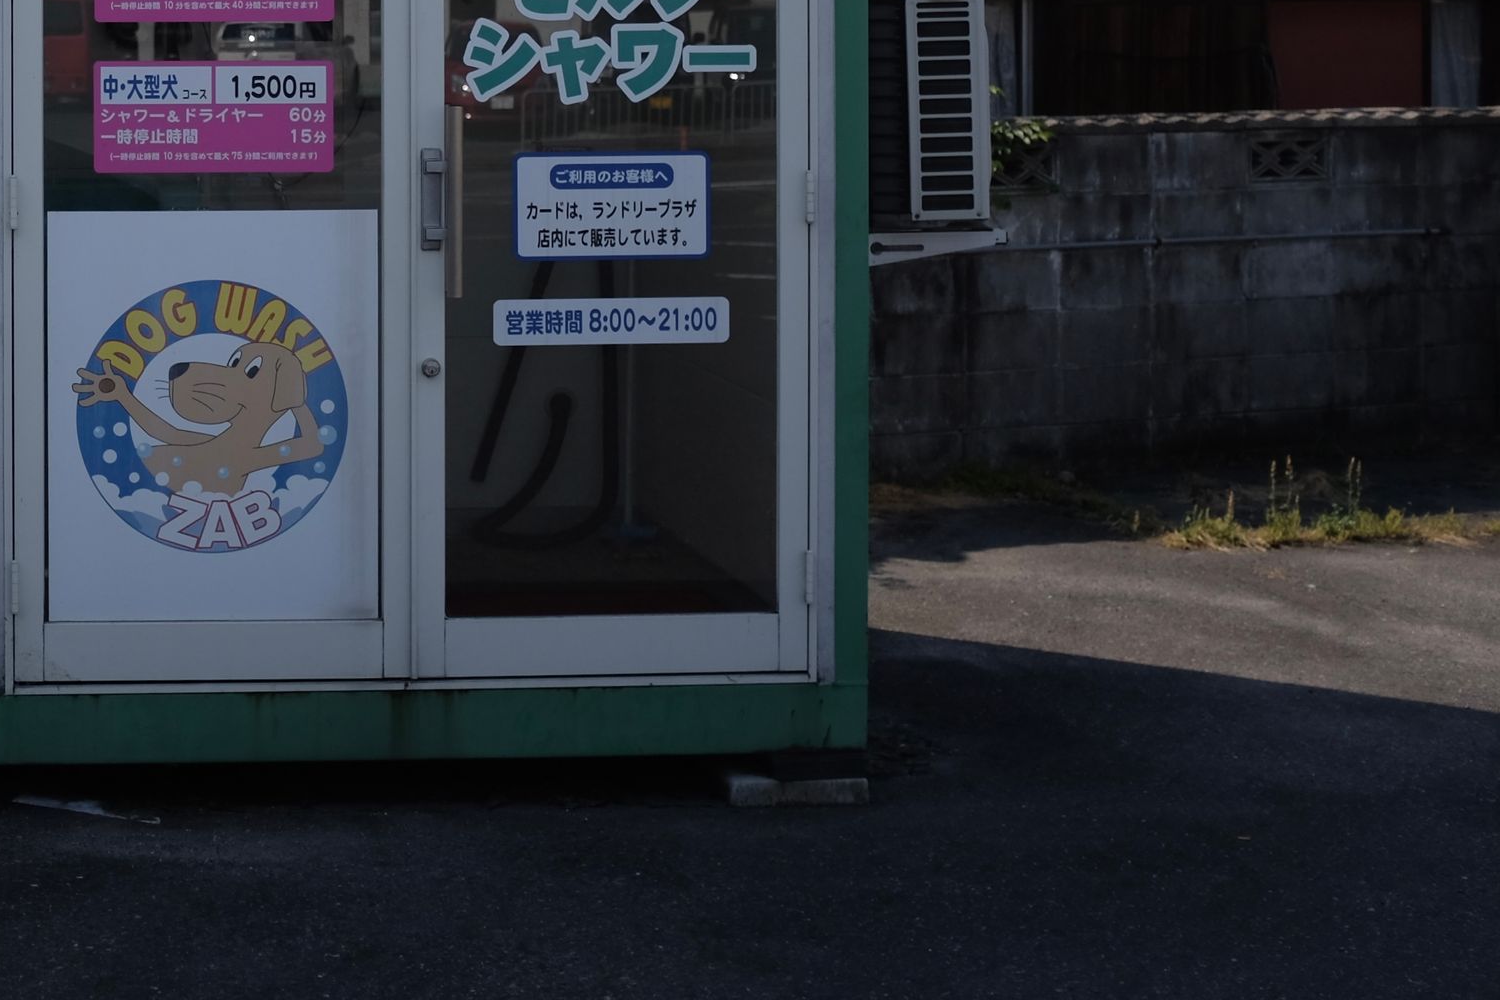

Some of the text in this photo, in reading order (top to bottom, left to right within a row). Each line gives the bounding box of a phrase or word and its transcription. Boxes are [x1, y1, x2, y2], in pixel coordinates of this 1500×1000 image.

[463, 18, 757, 105] シャワー
[231, 75, 316, 101] 1,500円
[101, 108, 326, 123] シャワー&ドライヤー 60分
[100, 129, 326, 144] 一時停止時間 15分
[554, 169, 668, 185] ご利用のお客様へ
[537, 227, 688, 249] 店内にて販売しています。
[96, 281, 335, 381] DOG WASH
[505, 310, 583, 336] 営業時間
[156, 490, 282, 550] ZAB
